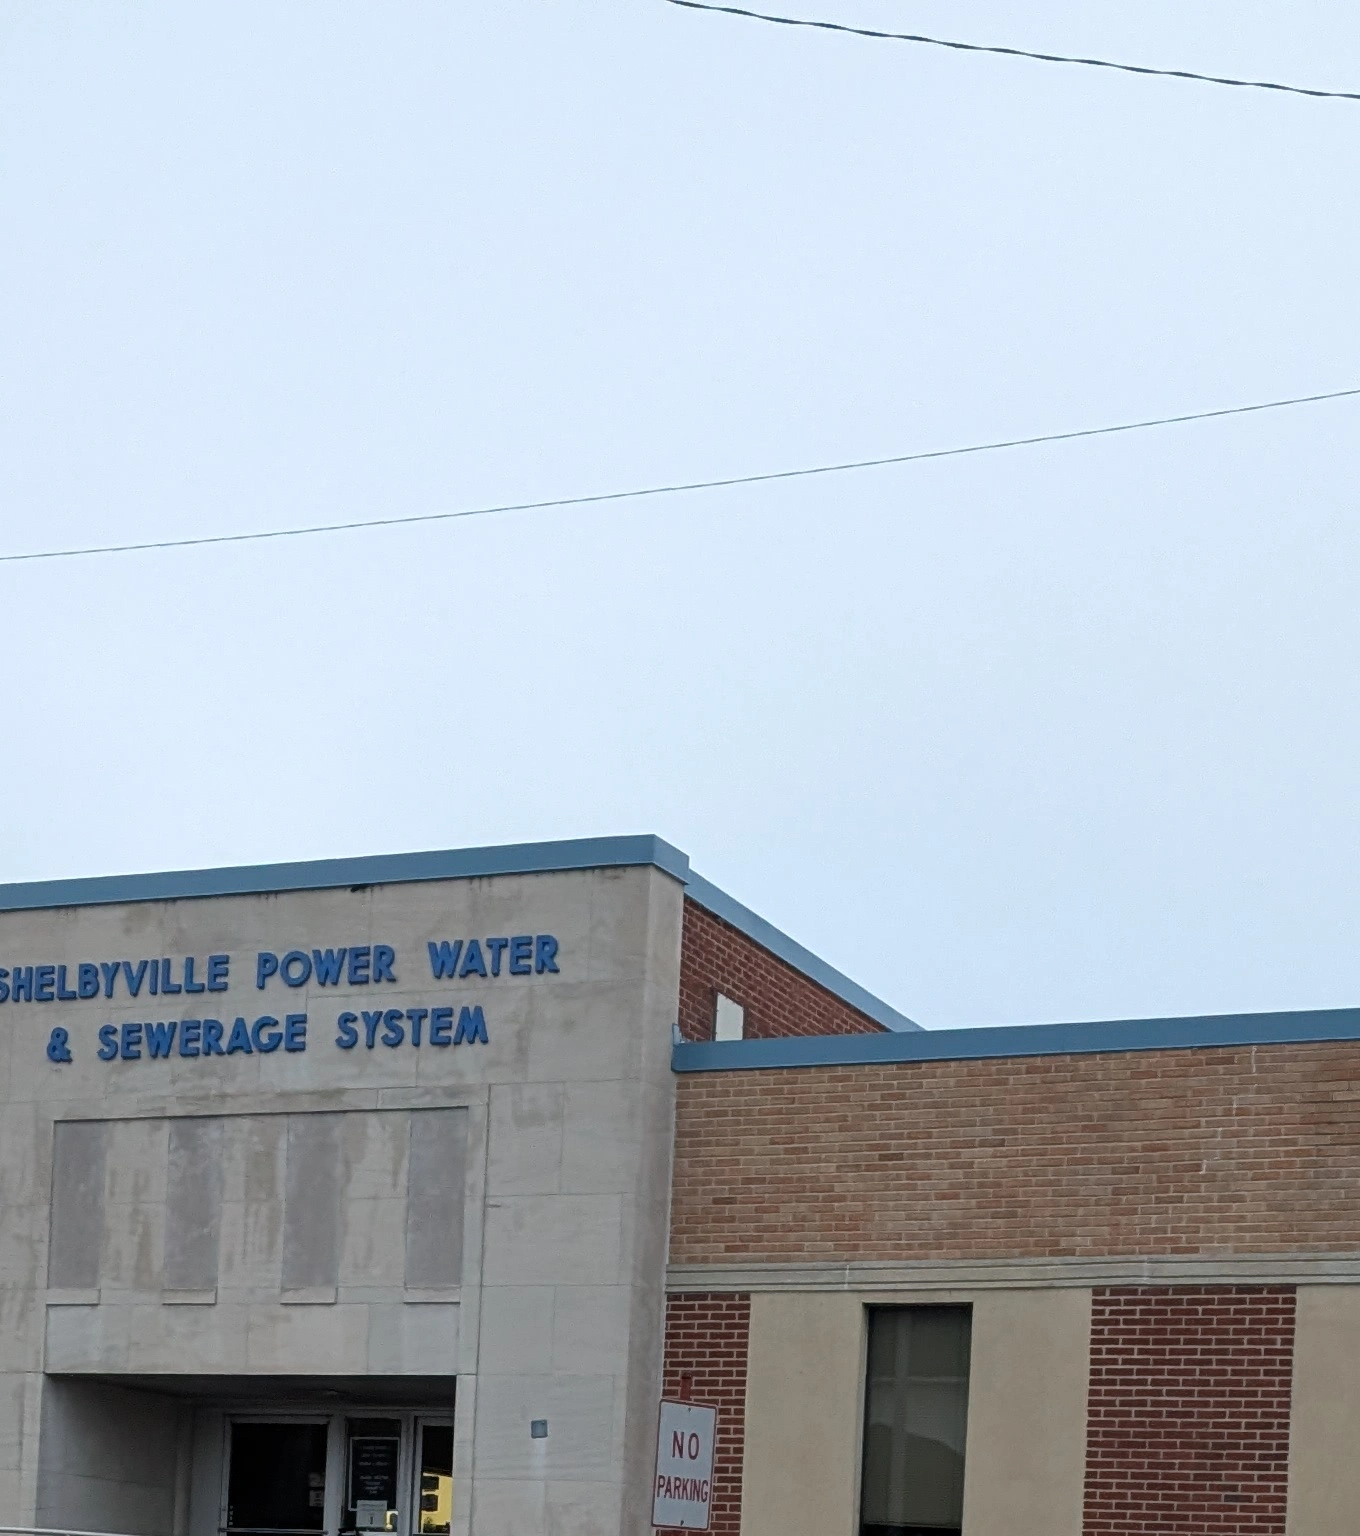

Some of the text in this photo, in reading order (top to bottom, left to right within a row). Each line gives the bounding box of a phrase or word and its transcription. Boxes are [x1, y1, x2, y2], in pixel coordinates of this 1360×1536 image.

[256, 944, 396, 990] POWER
[426, 934, 560, 980] WATER
[46, 1005, 489, 1063] & SEWERAGE SYSTEM
[673, 1430, 700, 1460] NO
[658, 1475, 709, 1502] PARKING
